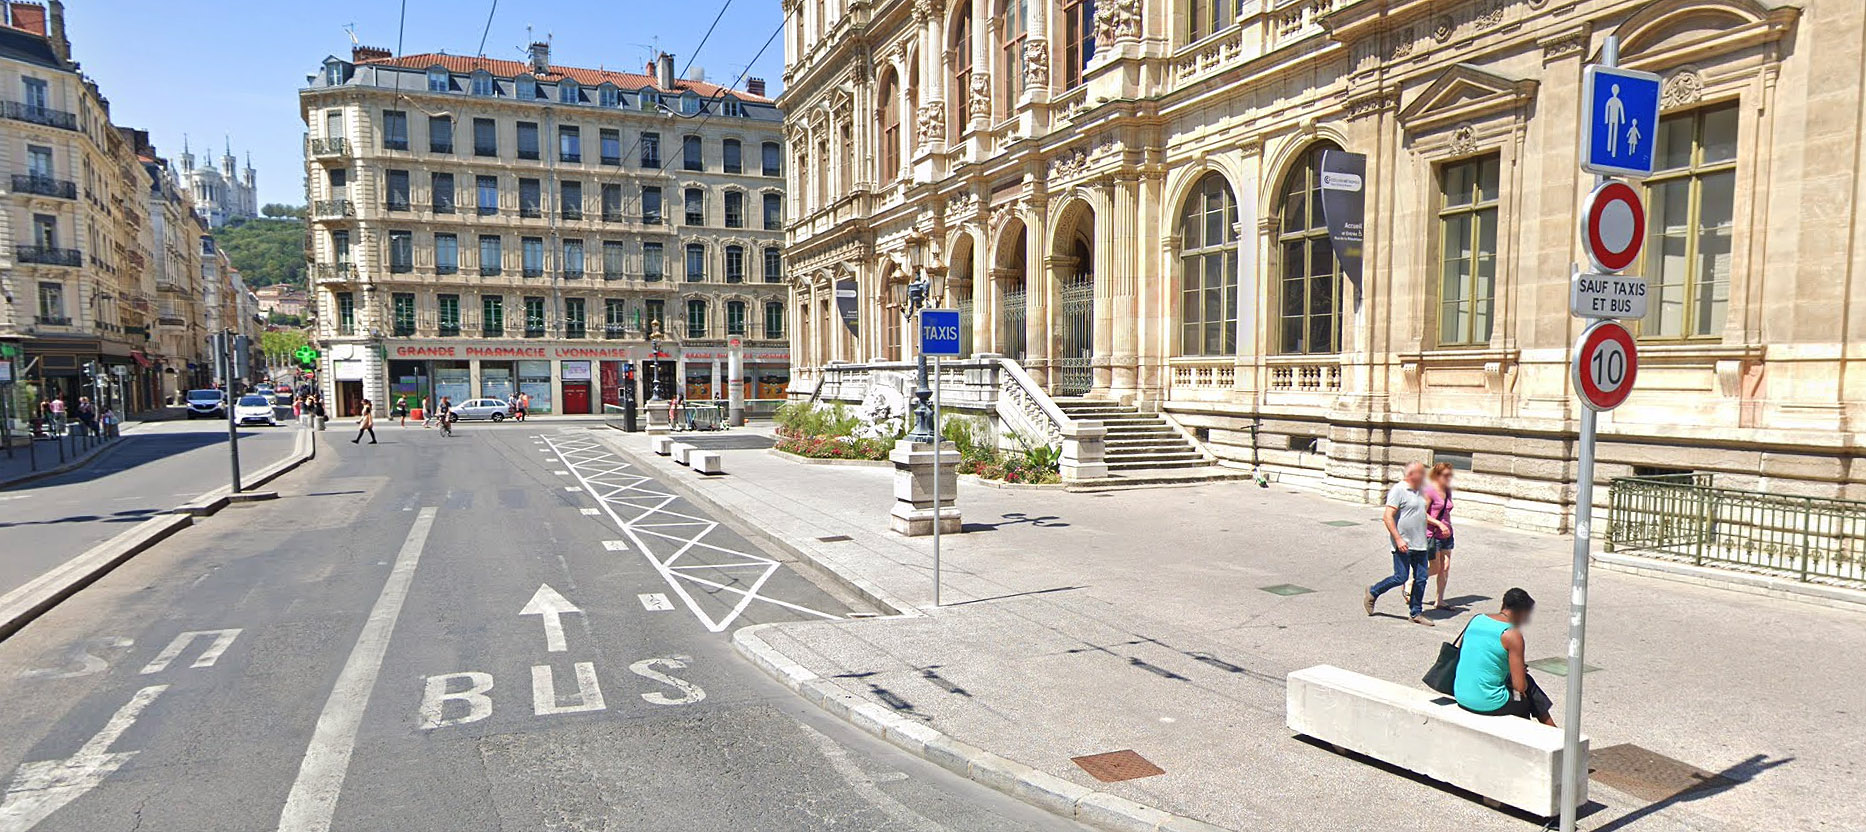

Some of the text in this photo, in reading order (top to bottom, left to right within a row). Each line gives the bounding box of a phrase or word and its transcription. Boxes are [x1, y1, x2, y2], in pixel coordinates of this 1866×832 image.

[1344, 222, 1363, 230] Accueil
[1579, 279, 1646, 296] SAUF TAXIS
[1592, 298, 1632, 312] ET BUS
[923, 326, 958, 341] TAXIS
[396, 346, 626, 358] GRANDE PHARMACIE LYONNAISE
[1592, 349, 1623, 385] 10
[418, 655, 706, 730] BUS
